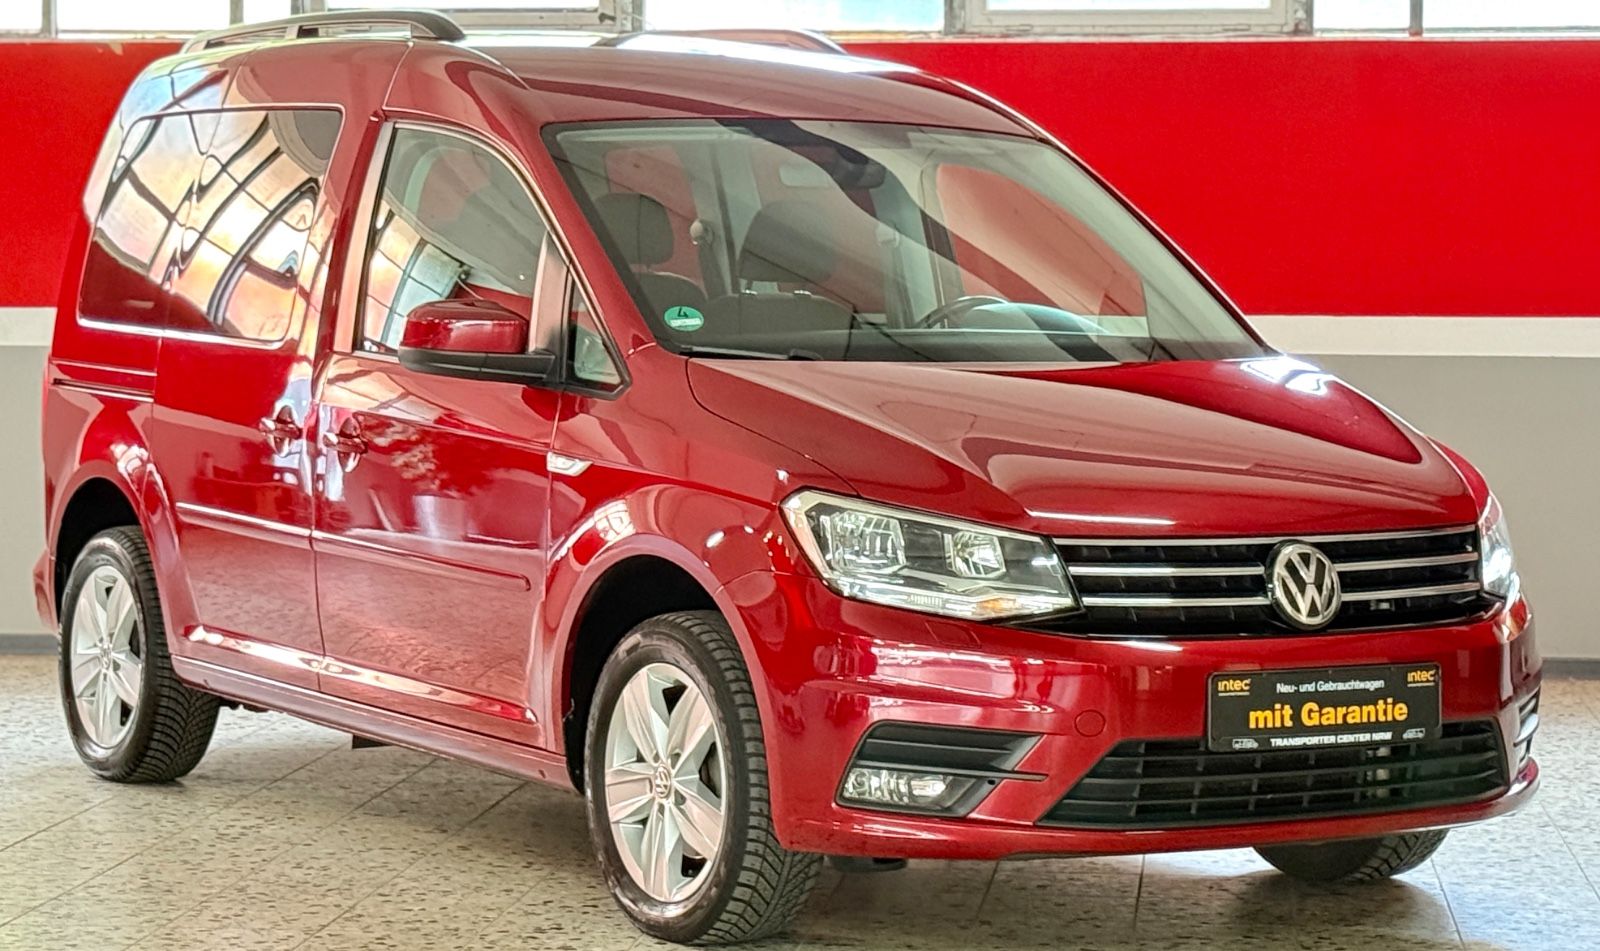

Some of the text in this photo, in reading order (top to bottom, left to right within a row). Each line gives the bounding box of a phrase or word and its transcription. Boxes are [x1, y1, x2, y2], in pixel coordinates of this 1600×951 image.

[677, 306, 689, 318] 4
[1407, 669, 1436, 682] intec
[1217, 679, 1251, 692] intec
[1276, 679, 1385, 694] Neu- und Gebrauchtwagen
[1248, 697, 1408, 729] mit Garantie
[1270, 731, 1393, 747] TRANSPORTER CENTER NRW
